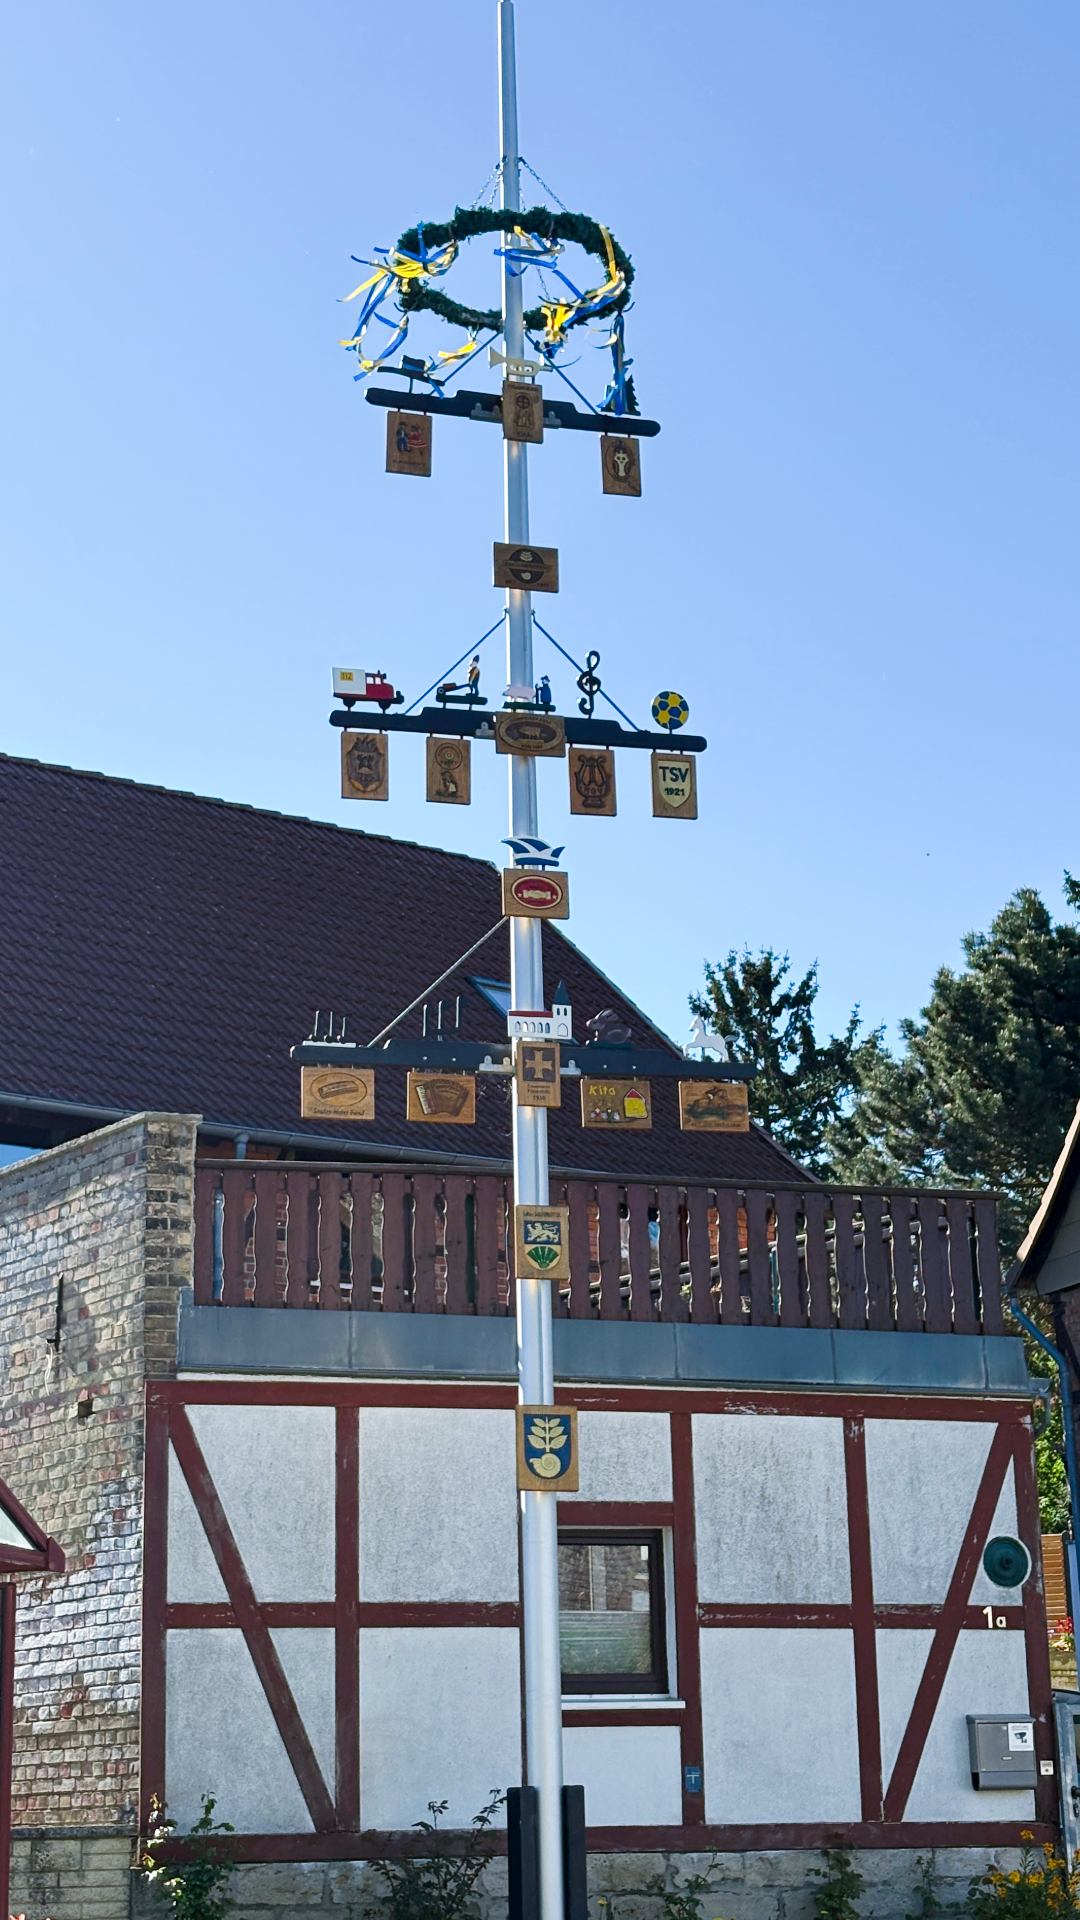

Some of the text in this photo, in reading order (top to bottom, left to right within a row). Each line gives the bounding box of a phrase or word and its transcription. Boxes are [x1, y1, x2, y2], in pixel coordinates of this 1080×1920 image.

[340, 671, 353, 681] 112
[659, 766, 689, 783] TSV
[664, 787, 685, 797] 1921
[589, 1085, 616, 1096] Kita
[982, 1606, 1006, 1628] 1a
